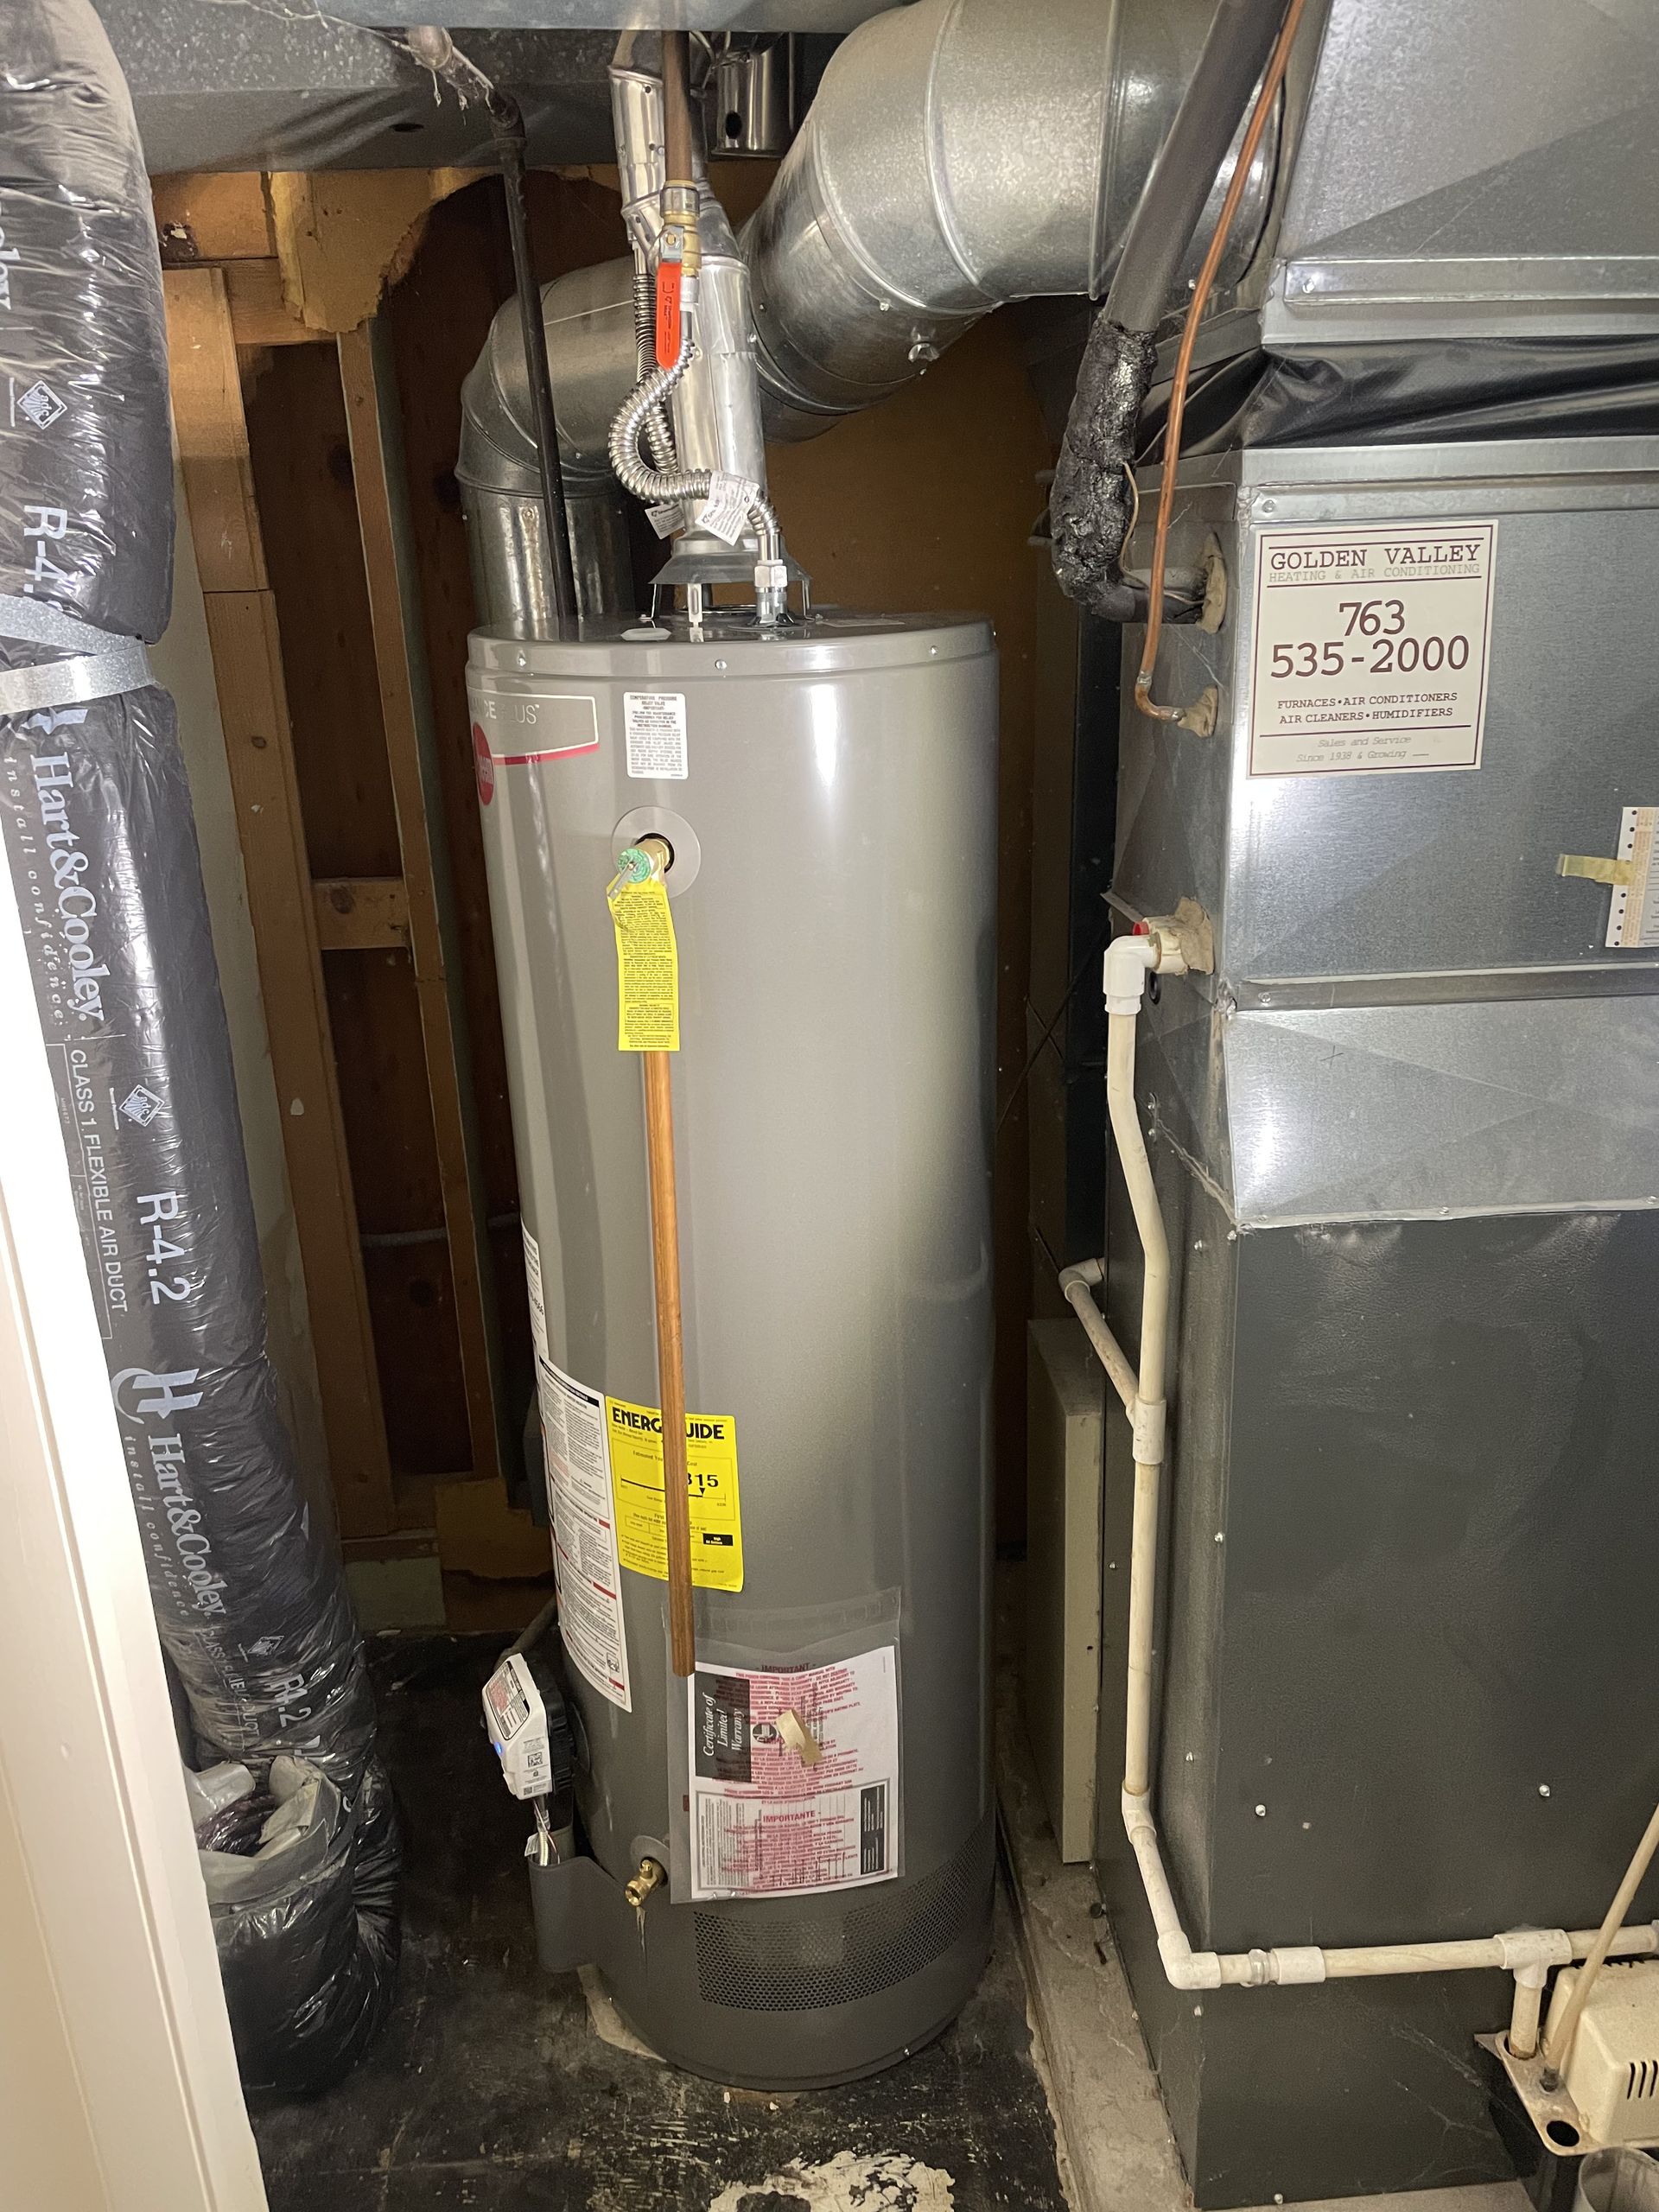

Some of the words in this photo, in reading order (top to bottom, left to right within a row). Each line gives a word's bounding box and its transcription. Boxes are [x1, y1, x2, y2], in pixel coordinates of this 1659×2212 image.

[24, 505, 68, 612] R-4.
[1269, 569, 1325, 583] HEATING
[1334, 569, 1342, 580] &
[1351, 568, 1375, 580] AIR
[1383, 563, 1480, 577] CONDITIONING
[1271, 549, 1367, 570] GOLDEN
[1384, 543, 1481, 564] VALLEY
[1338, 600, 1406, 637] 763
[1270, 635, 1470, 678] 535-2000
[1369, 692, 1458, 705] CONDITIONERS
[1279, 715, 1302, 725] AIR
[1318, 738, 1346, 748] Sales
[1351, 736, 1369, 747] and
[1372, 734, 1412, 746] Service
[71, 1049, 95, 1114] CLASS
[84, 1134, 113, 1222] FLEXIBLE
[99, 1225, 118, 1257] AIR
[137, 1191, 192, 1305] R-4.2
[105, 1261, 128, 1313] DUCT
[612, 1407, 725, 1440] ENERGUIDE
[702, 1706, 716, 1757] Certificate
[717, 1710, 728, 1747] Limited
[763, 1810, 816, 1823] IMPORTANTE
